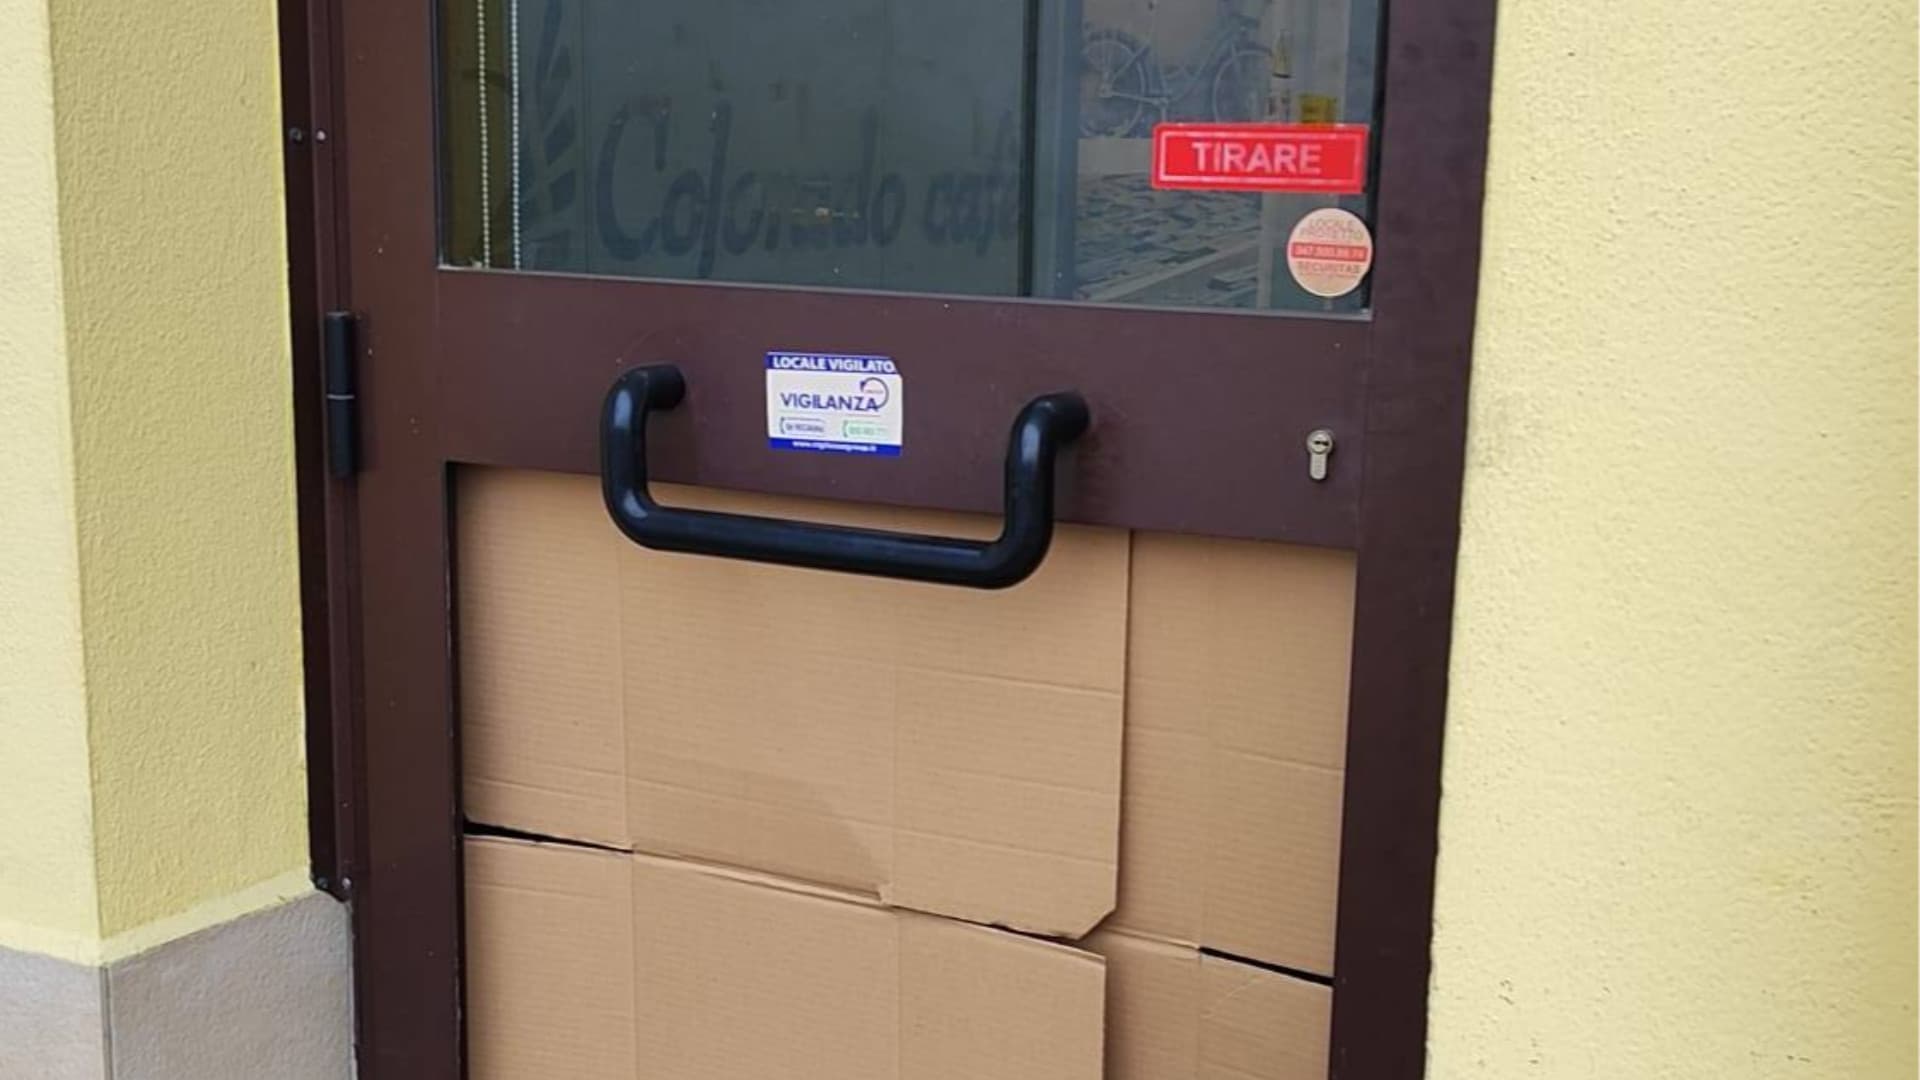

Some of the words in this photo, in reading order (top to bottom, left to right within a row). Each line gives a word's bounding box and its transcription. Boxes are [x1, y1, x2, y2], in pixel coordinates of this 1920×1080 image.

[1191, 141, 1322, 175] TIRARE
[773, 356, 827, 370] LOCALE
[828, 358, 896, 373] VIGILATO
[780, 392, 879, 412] VIGILANZA
